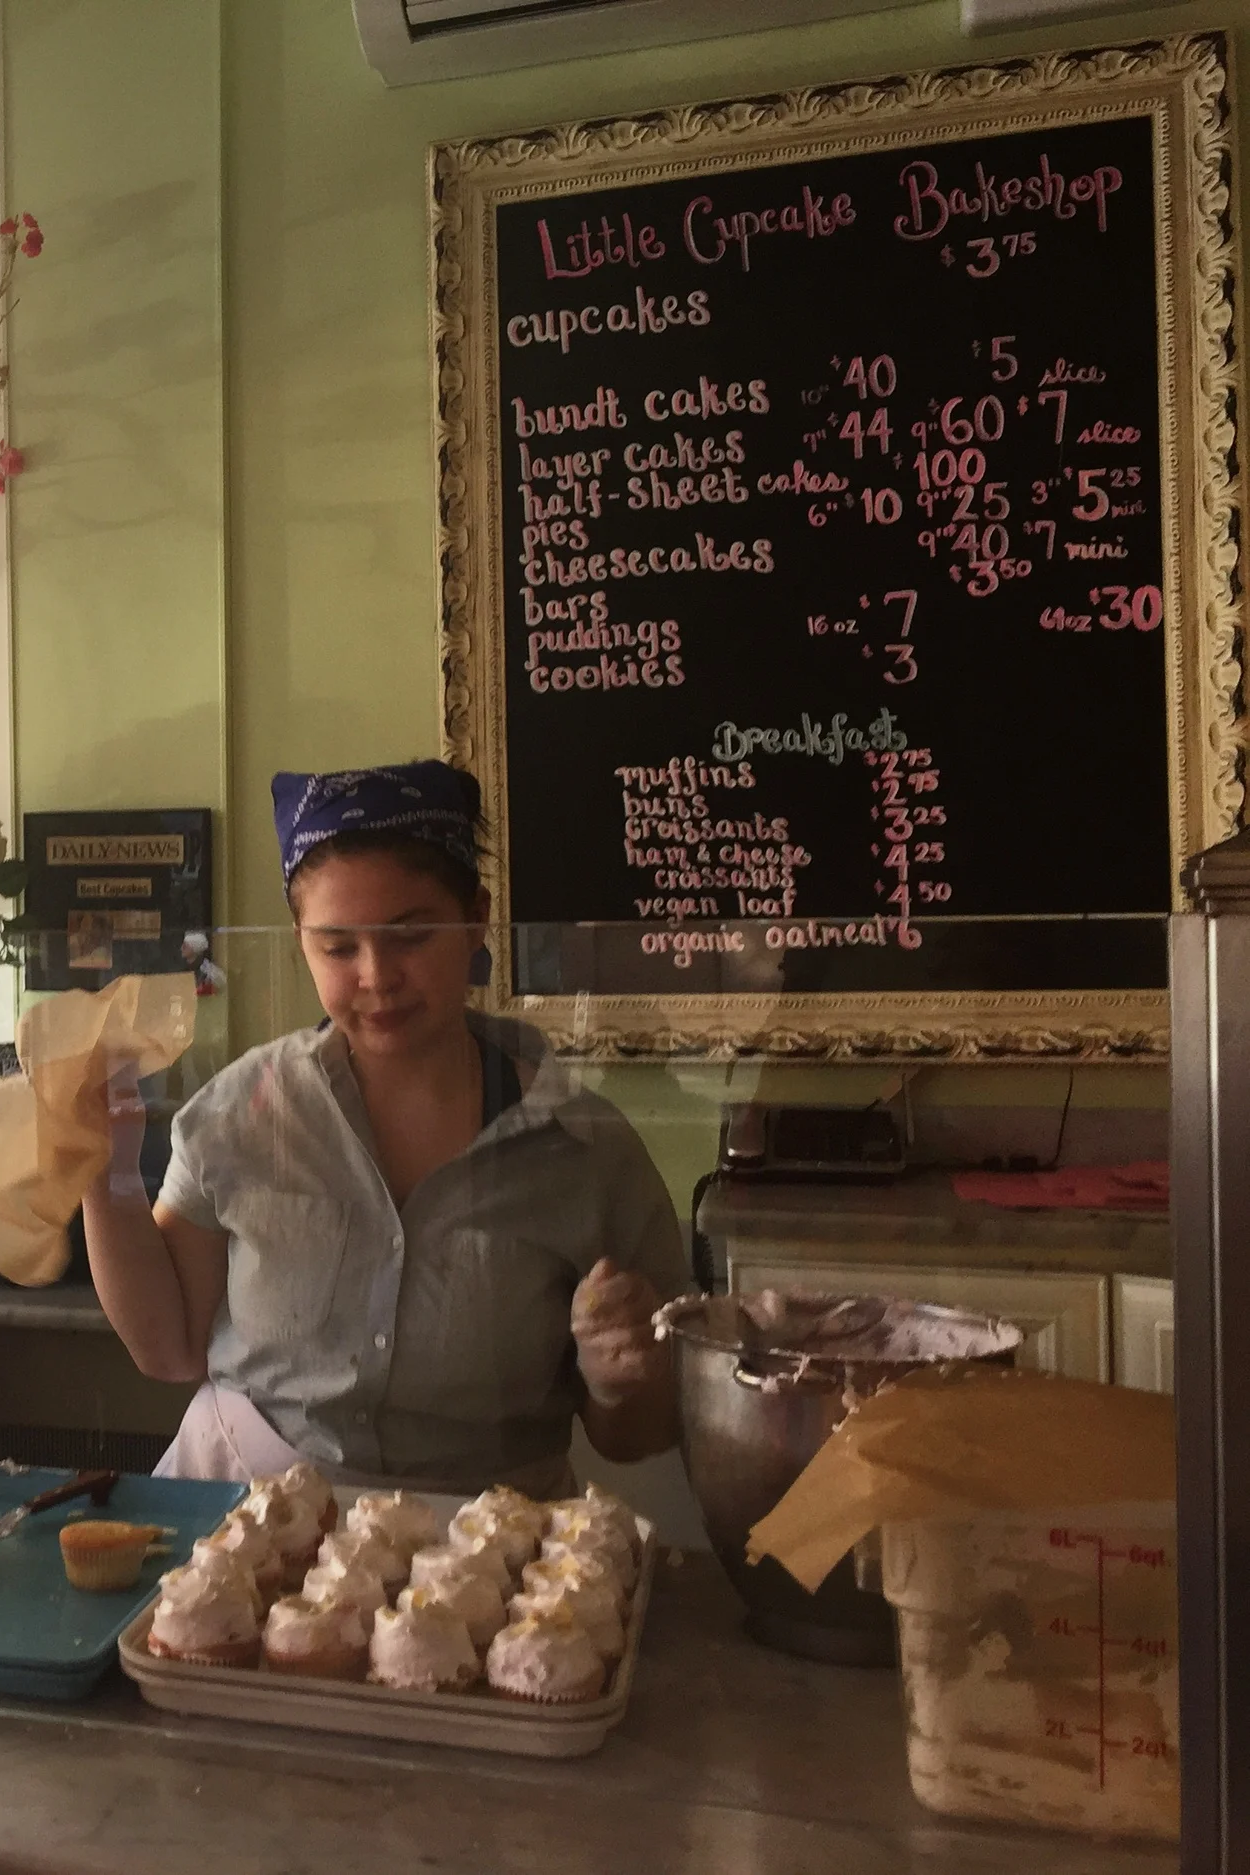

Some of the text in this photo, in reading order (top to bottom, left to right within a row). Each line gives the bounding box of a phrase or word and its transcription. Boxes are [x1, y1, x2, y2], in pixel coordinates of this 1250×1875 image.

[536, 152, 1125, 281] Little Cupcake Bakeshop
[506, 285, 712, 354] cupcakes
[511, 385, 628, 438] bundt
[644, 375, 771, 421] cakes
[1039, 357, 1107, 387] slice
[518, 442, 612, 491] layer
[623, 430, 747, 473] cakes
[1076, 420, 1142, 445] slice
[756, 458, 850, 497] cakes
[519, 518, 591, 566] pies
[523, 532, 776, 588] cheesecakes
[1064, 535, 1129, 561] mini
[519, 586, 610, 627] bars
[524, 619, 683, 672] puddings
[529, 653, 686, 694] cookies
[712, 707, 908, 767] Breakfast
[614, 755, 757, 797] muffins
[622, 790, 710, 820] buns
[624, 811, 790, 845] croissants
[52, 842, 180, 860] DAILY NEWS
[624, 837, 692, 870] ham
[719, 843, 813, 869] cheese
[654, 866, 796, 892] croissants
[634, 896, 720, 930] vegan
[737, 889, 798, 917] loaf
[640, 923, 746, 969] organic
